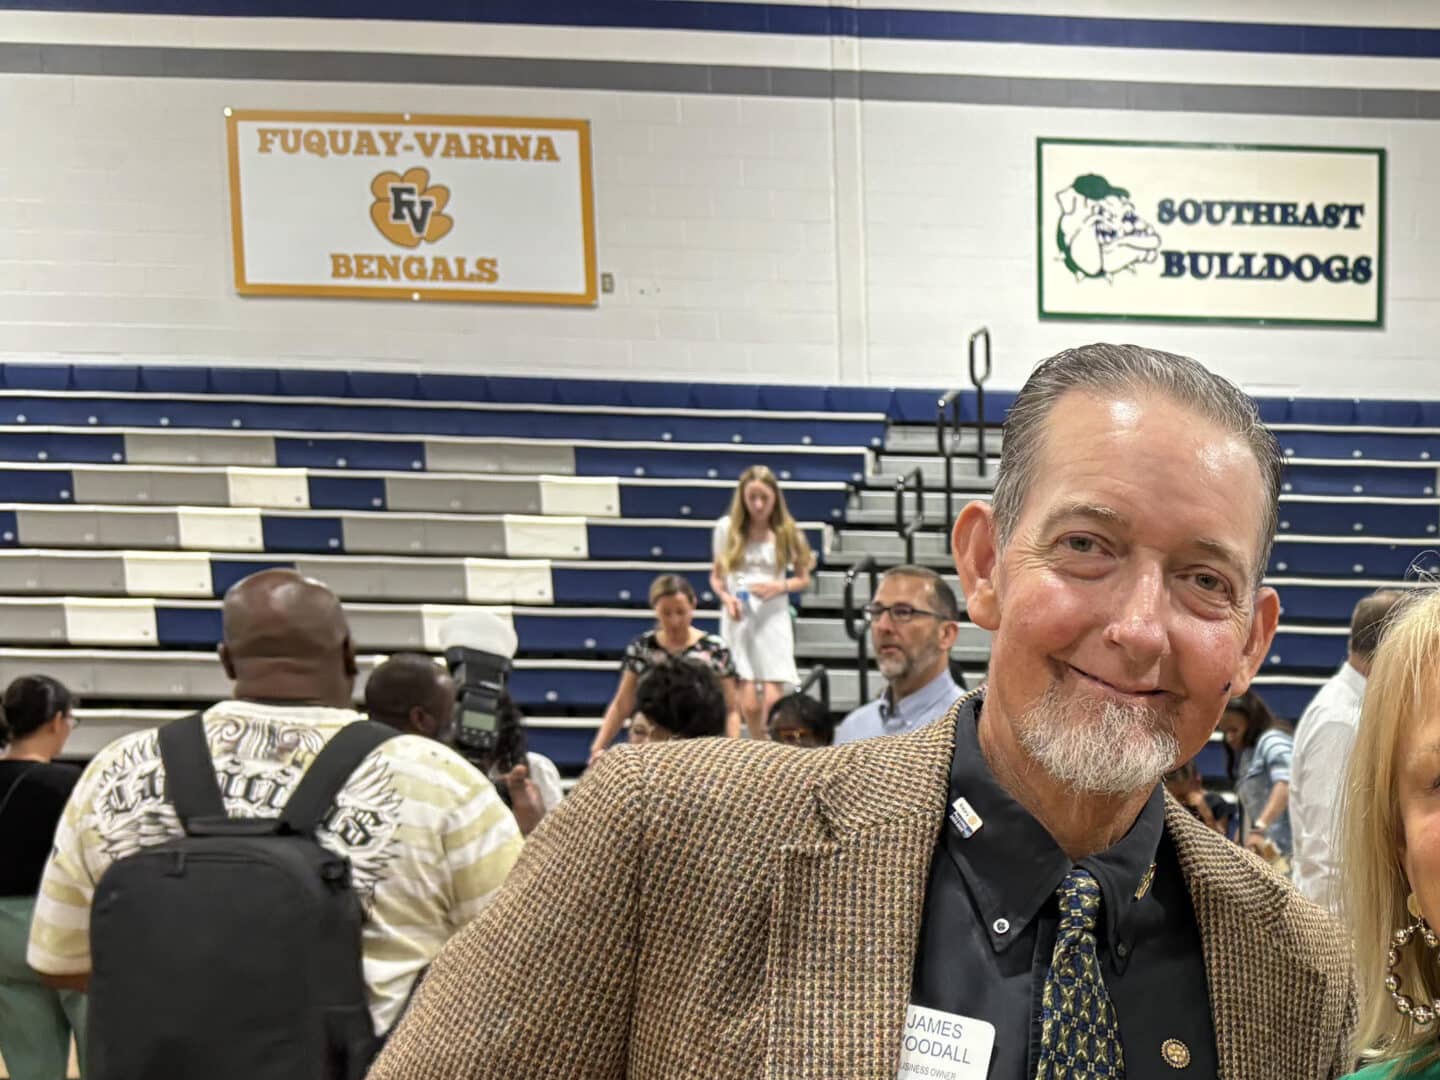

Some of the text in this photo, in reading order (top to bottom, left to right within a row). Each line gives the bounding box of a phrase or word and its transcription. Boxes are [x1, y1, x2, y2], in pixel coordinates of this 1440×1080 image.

[256, 128, 560, 163] FUQUAY-VARINA
[390, 187, 433, 235] FV
[1157, 198, 1365, 229] SOUTHEAST
[331, 254, 499, 284] BENGALS
[1160, 251, 1373, 284] BULLDOGS
[907, 1014, 964, 1040] JAMES
[903, 1035, 971, 1065] OODALL
[930, 1067, 957, 1080] OWNER
